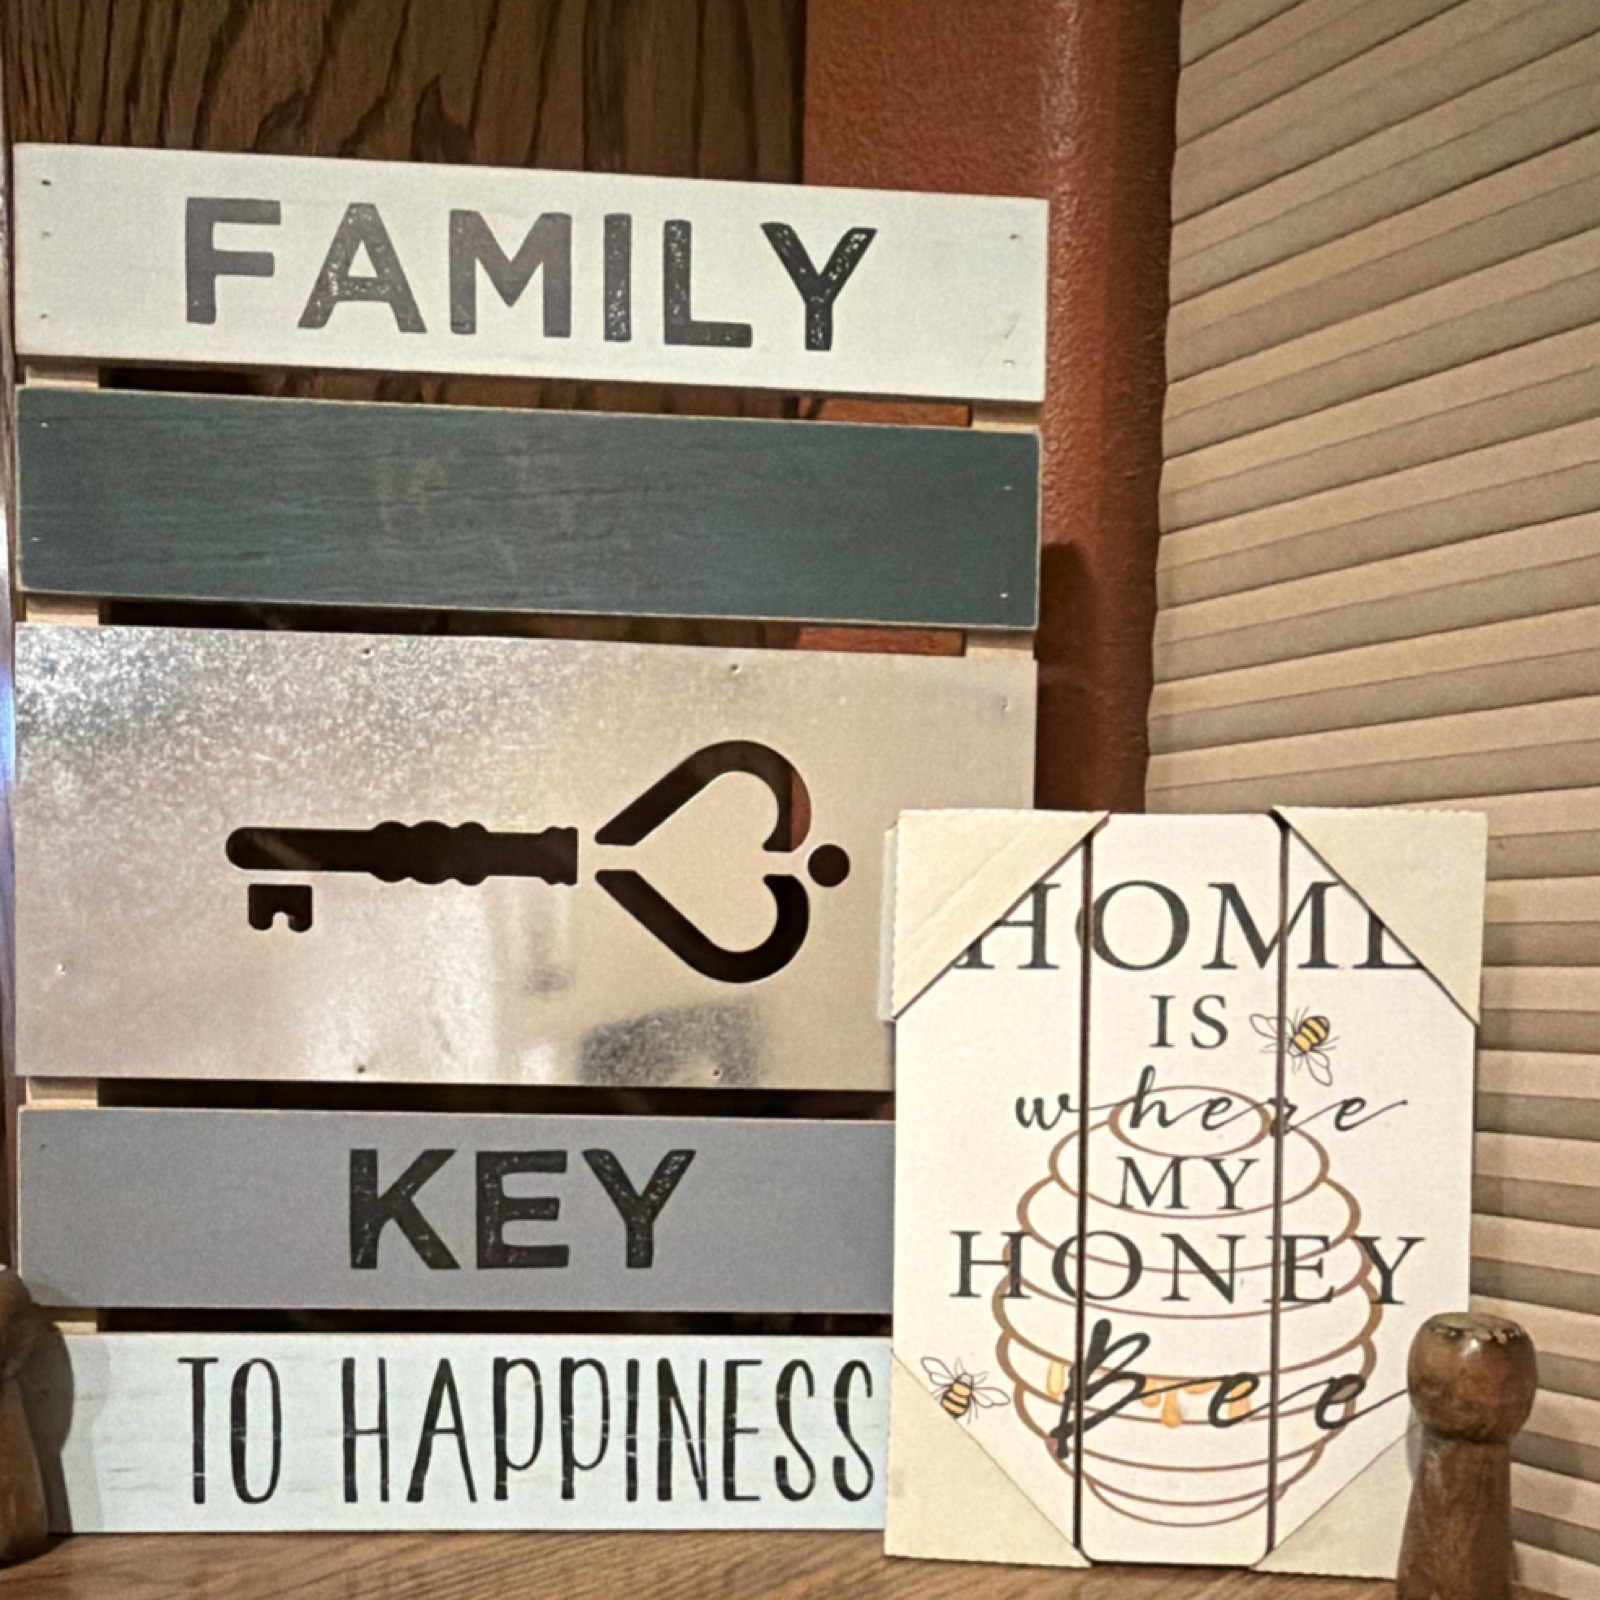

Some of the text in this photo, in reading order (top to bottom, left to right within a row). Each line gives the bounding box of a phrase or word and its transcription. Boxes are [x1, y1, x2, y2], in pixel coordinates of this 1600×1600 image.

[185, 196, 877, 351] FAMILY
[1149, 994, 1229, 1050] IS
[1014, 1064, 1408, 1137] where
[349, 1148, 697, 1270] KEY
[1117, 1155, 1260, 1210] MY
[948, 1230, 1426, 1306] HONEY
[177, 1356, 875, 1505] TO HAPPINESS
[1049, 1318, 1409, 1459] Bee
